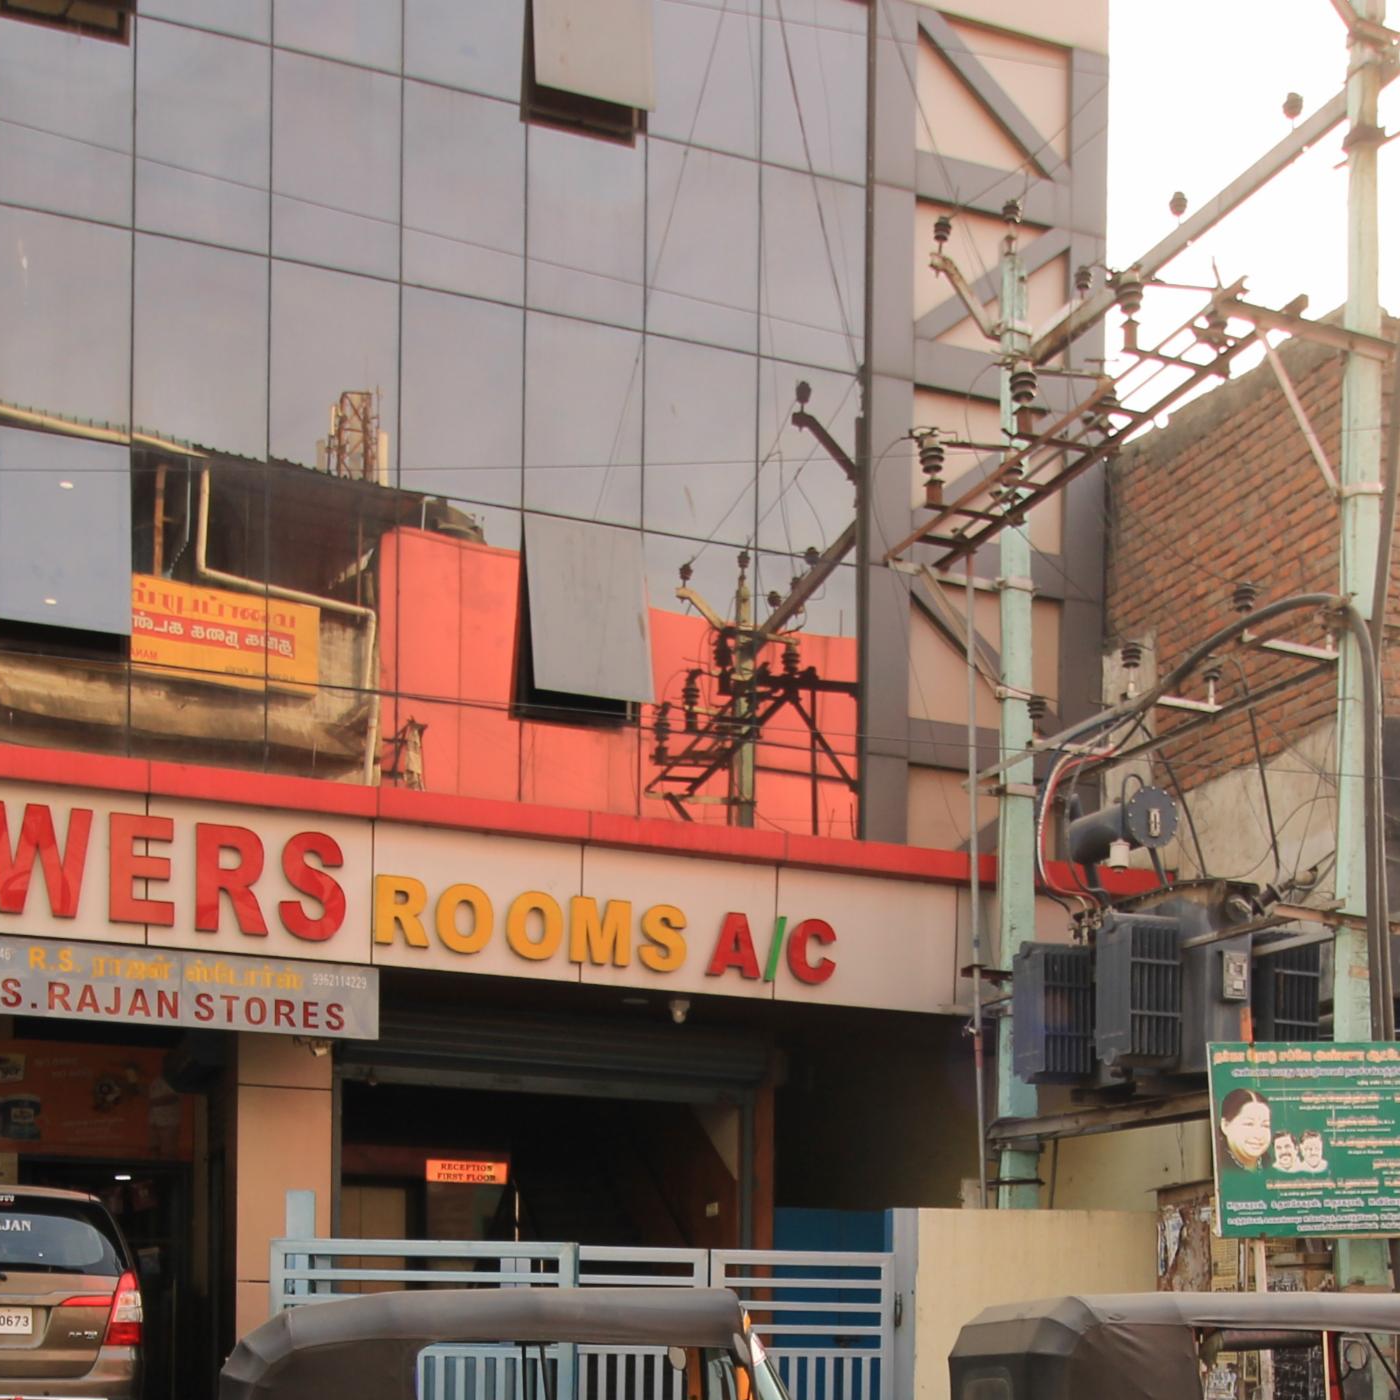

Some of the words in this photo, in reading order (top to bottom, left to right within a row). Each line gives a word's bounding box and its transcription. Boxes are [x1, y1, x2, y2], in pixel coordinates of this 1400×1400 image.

[374, 873, 687, 972] ROOMS
[706, 911, 837, 986] A/C
[193, 992, 346, 1032] STORES
[437, 1172, 463, 1180] FIRST
[466, 1174, 496, 1182] FLOOR
[440, 1163, 493, 1172] RECEPTION
